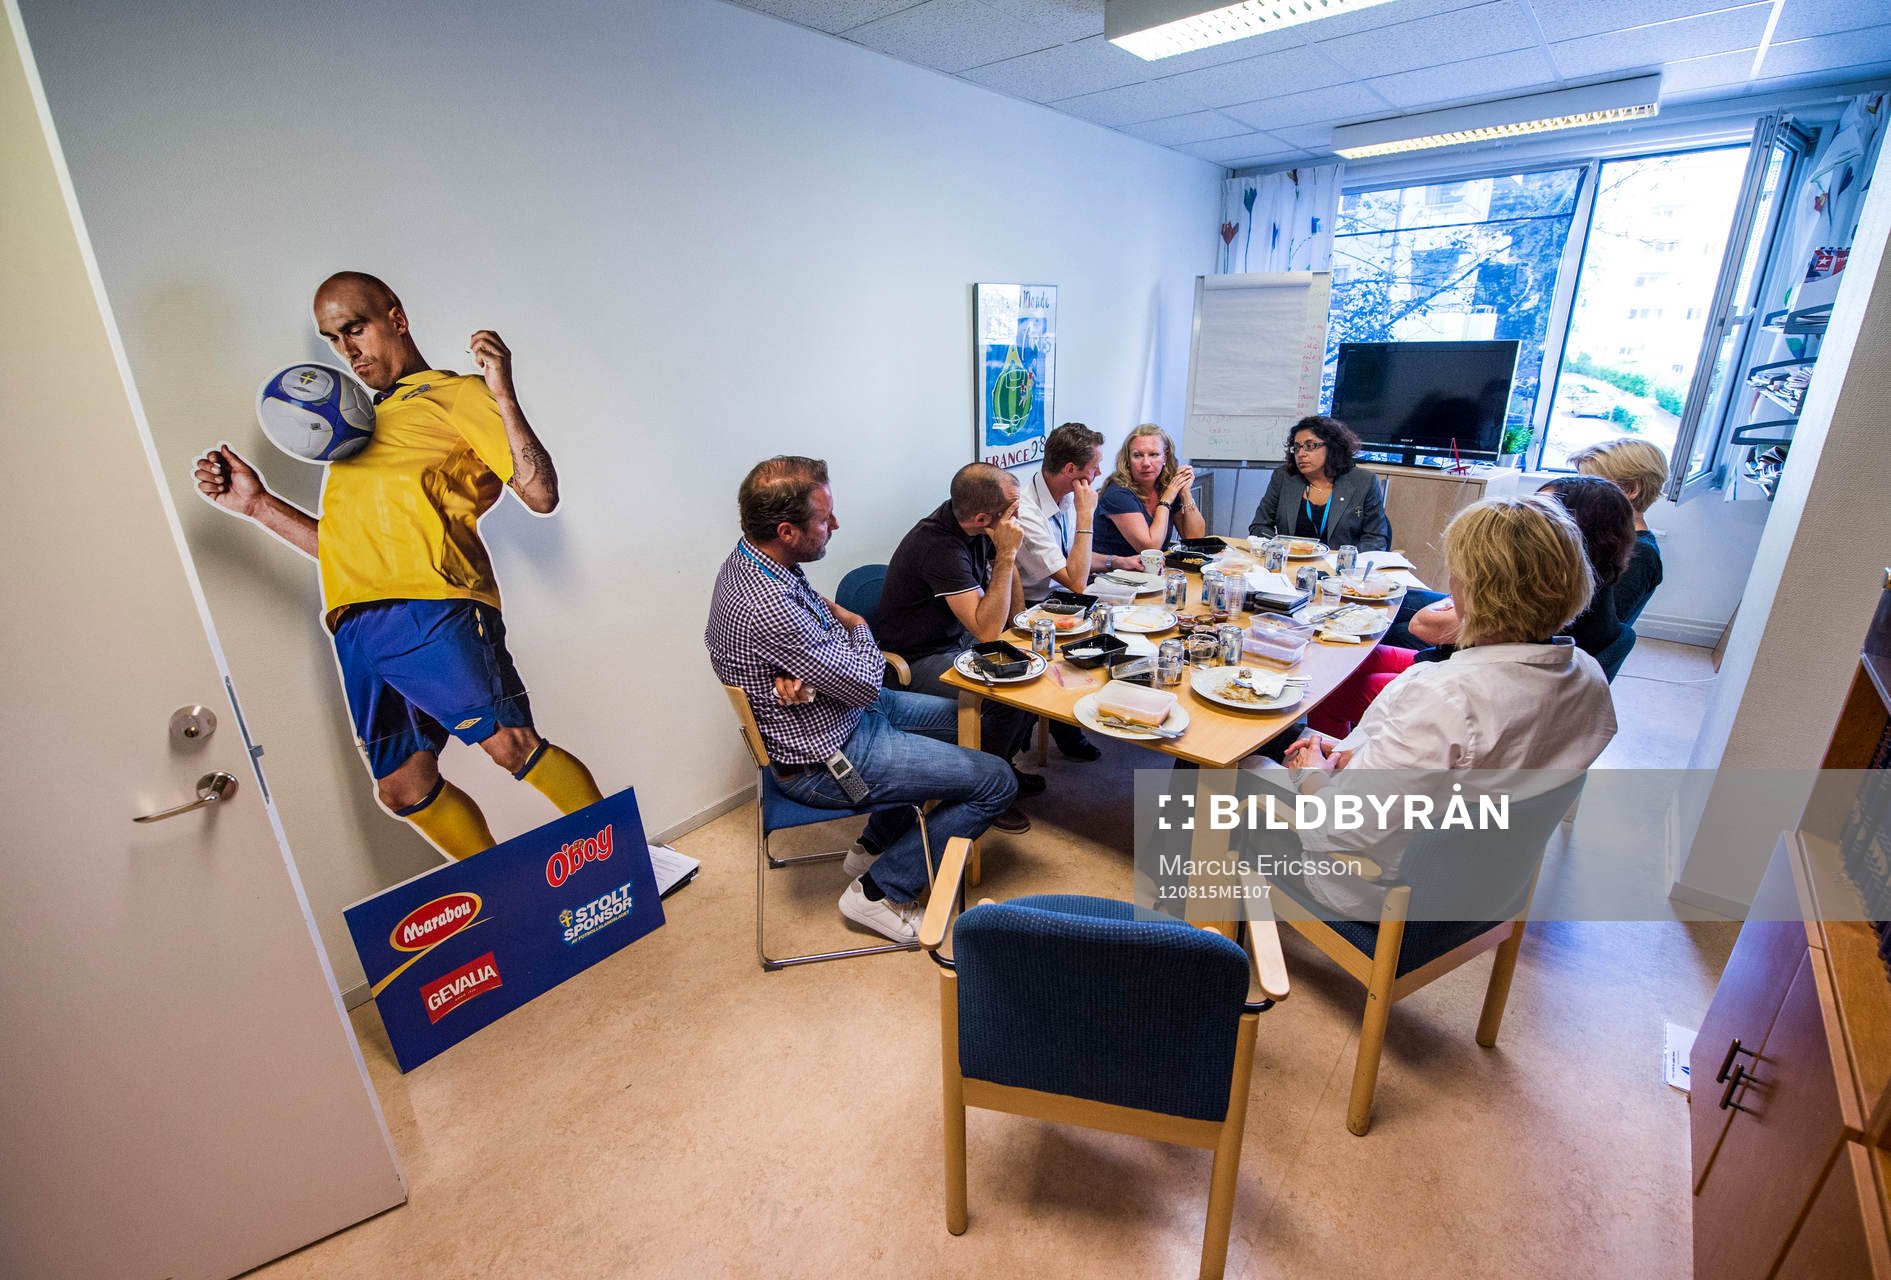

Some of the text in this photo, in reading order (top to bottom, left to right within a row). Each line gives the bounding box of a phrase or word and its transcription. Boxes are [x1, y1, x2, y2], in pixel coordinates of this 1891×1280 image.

[985, 448, 1031, 467] FRANCE
[546, 824, 614, 888] O'boy
[403, 901, 471, 943] Marabou
[564, 897, 632, 941] SPONSOR
[576, 883, 631, 923] STOLT
[428, 964, 498, 1012] GEVALIA
